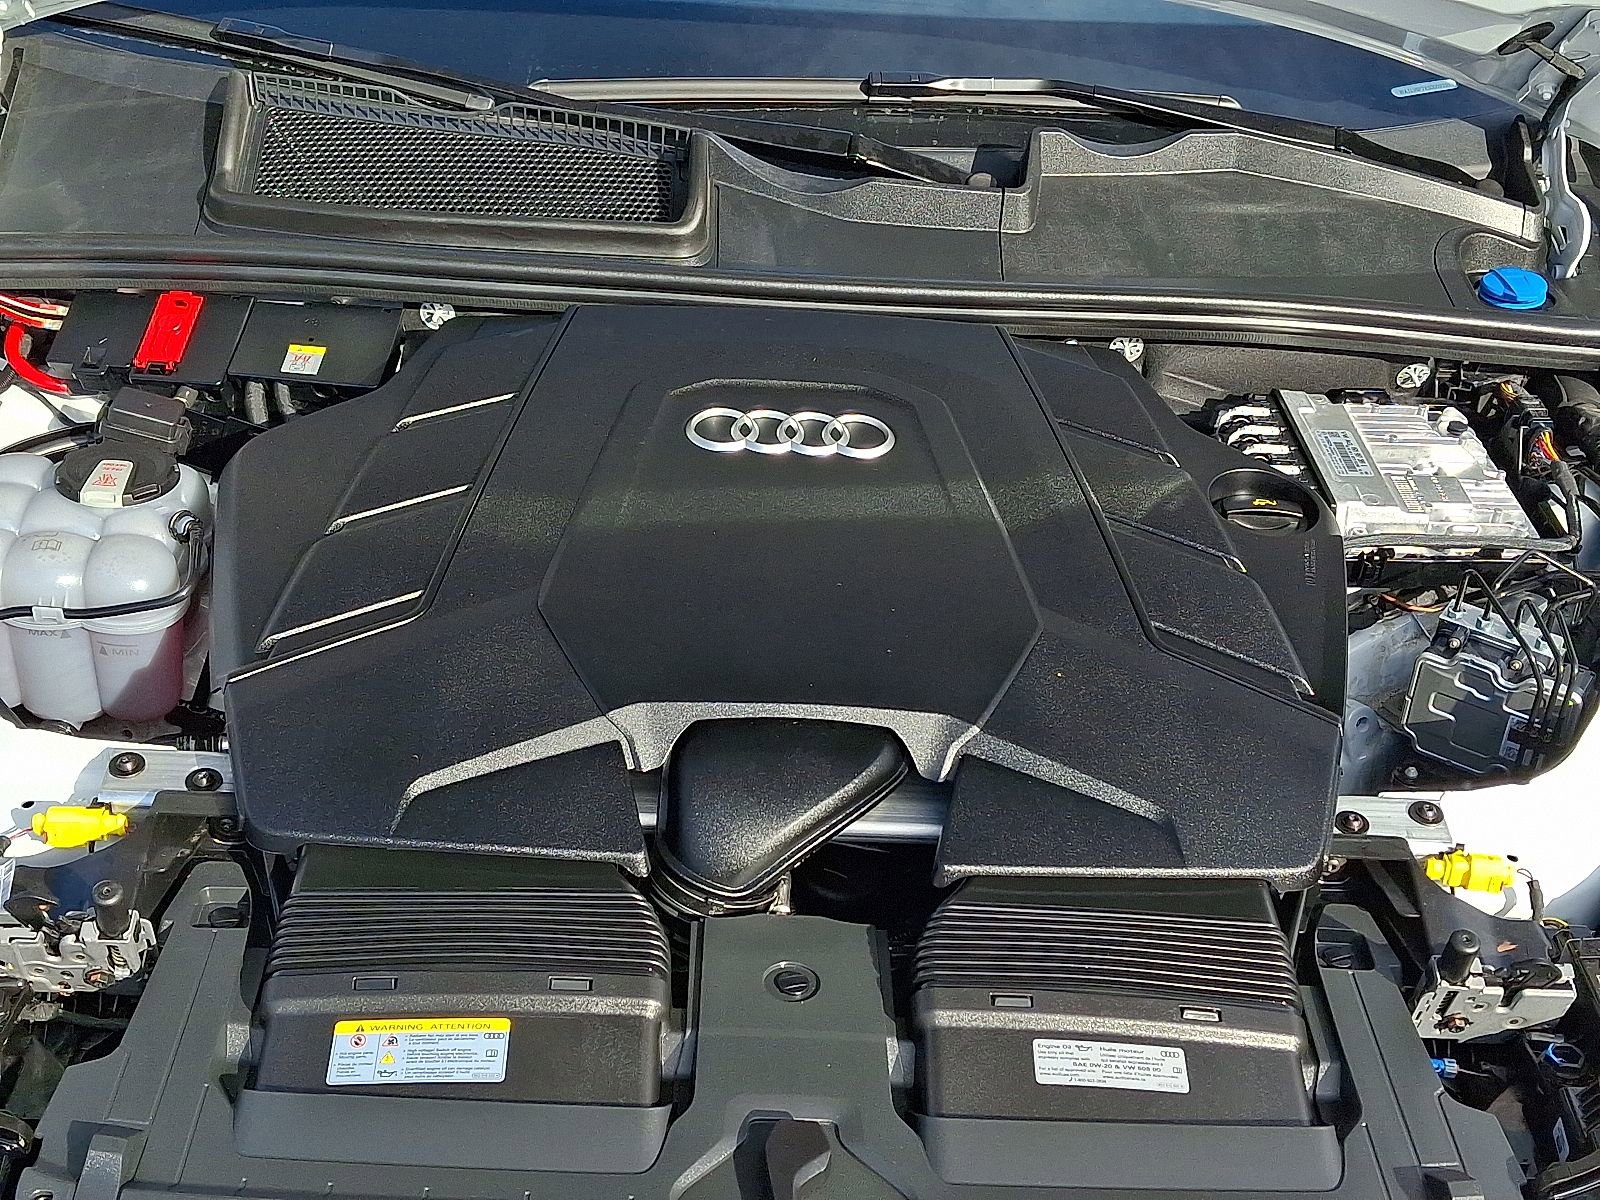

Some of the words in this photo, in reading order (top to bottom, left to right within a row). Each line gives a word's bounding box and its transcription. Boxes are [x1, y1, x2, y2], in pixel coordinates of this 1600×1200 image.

[28, 629, 58, 637] MAX
[112, 648, 140, 657] MIN
[369, 1023, 424, 1032] WARNING
[430, 1022, 491, 1031] ATTENTION
